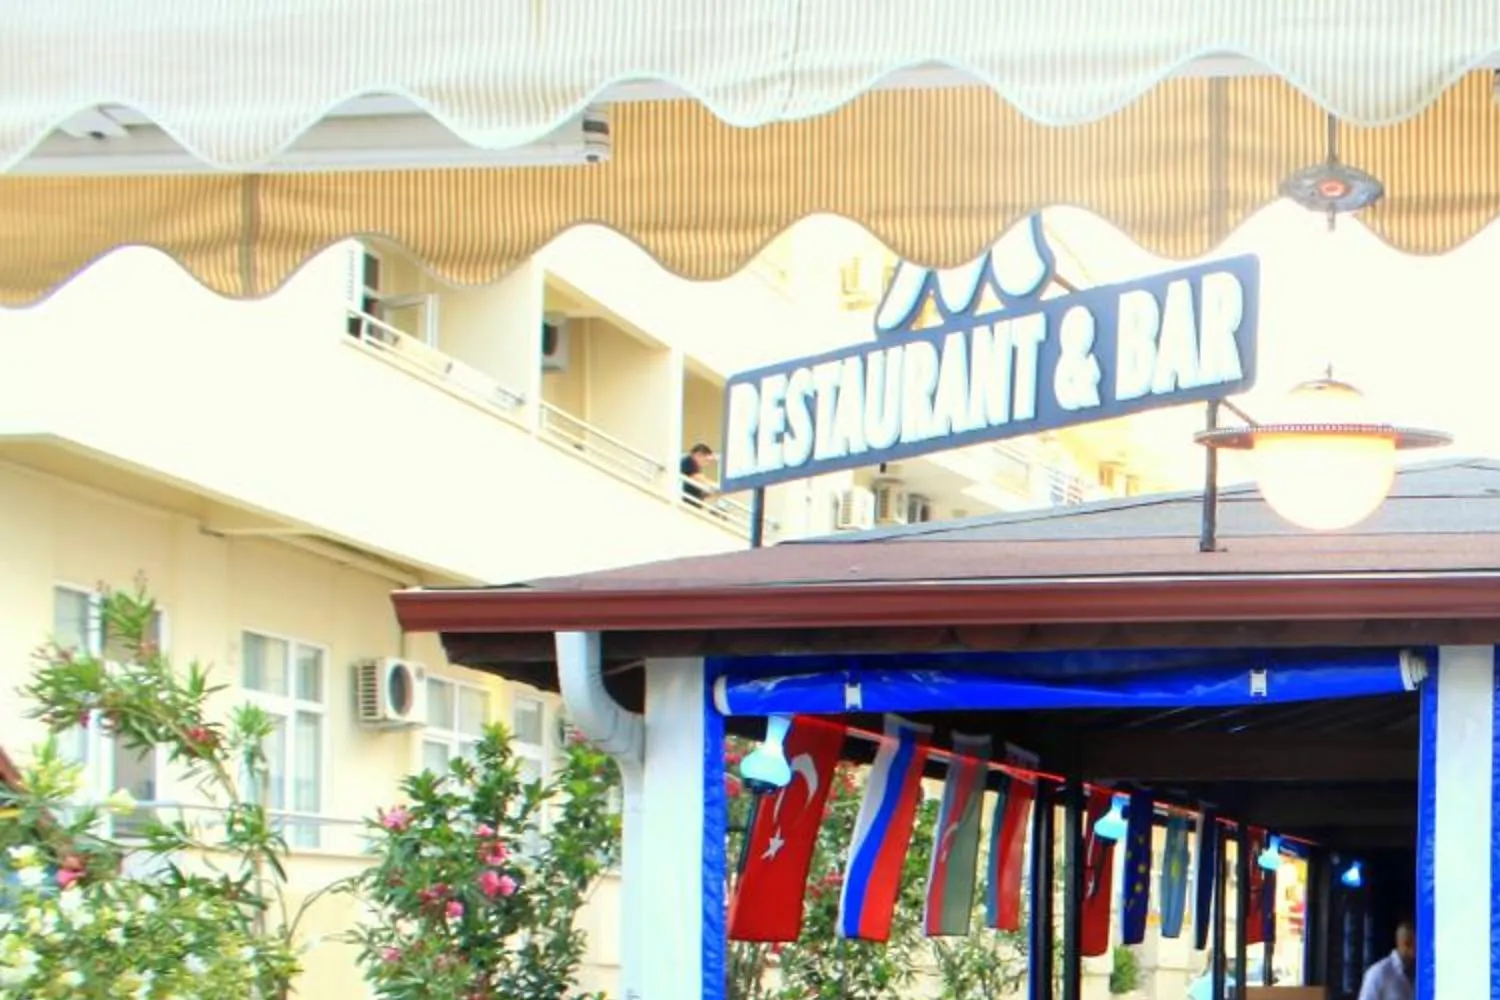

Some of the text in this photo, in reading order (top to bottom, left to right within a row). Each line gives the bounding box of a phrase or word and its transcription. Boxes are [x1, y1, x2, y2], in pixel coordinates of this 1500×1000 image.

[726, 312, 1047, 479] RESTAURANT
[1054, 305, 1101, 411] &
[1115, 271, 1243, 400] BAR
